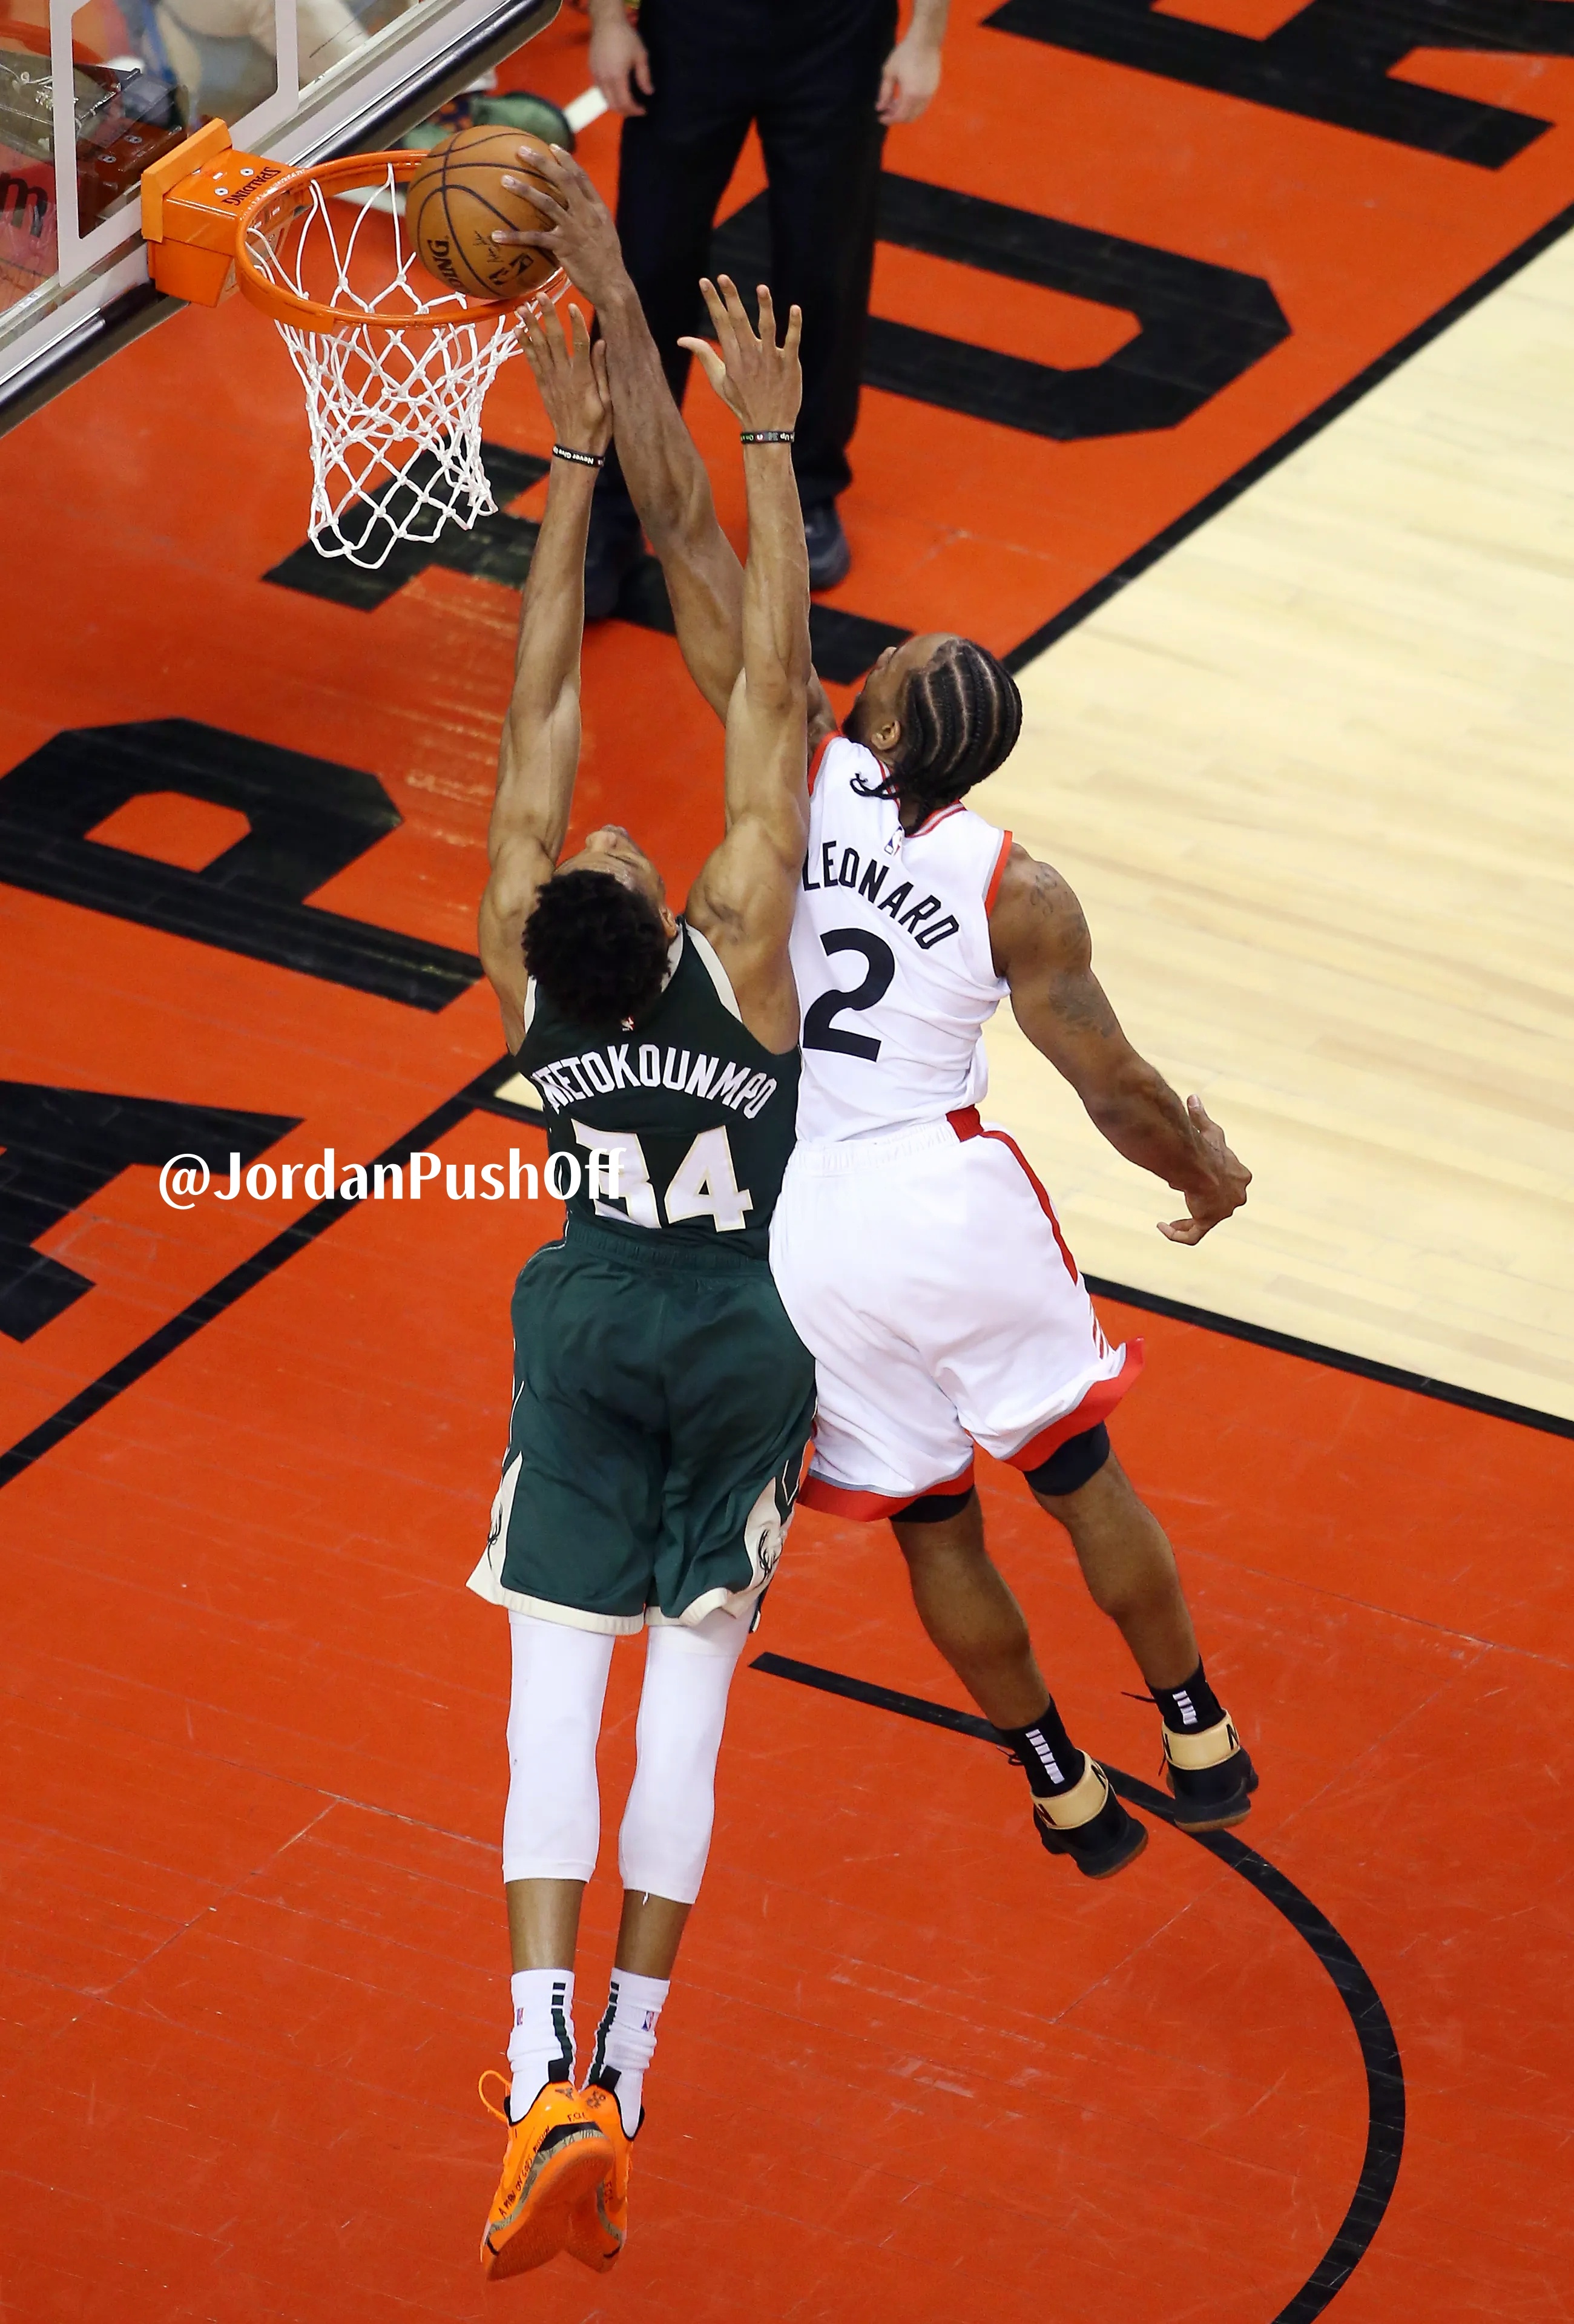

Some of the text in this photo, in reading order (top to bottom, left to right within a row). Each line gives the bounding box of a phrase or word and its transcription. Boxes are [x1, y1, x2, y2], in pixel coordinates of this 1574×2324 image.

[221, 166, 281, 206] SPALDING
[558, 449, 571, 459] Give
[572, 453, 594, 465] Never
[802, 840, 960, 950] LEONARD
[802, 927, 895, 1062] 2
[571, 1118, 754, 1233] 34
[498, 2207, 507, 2219] A
